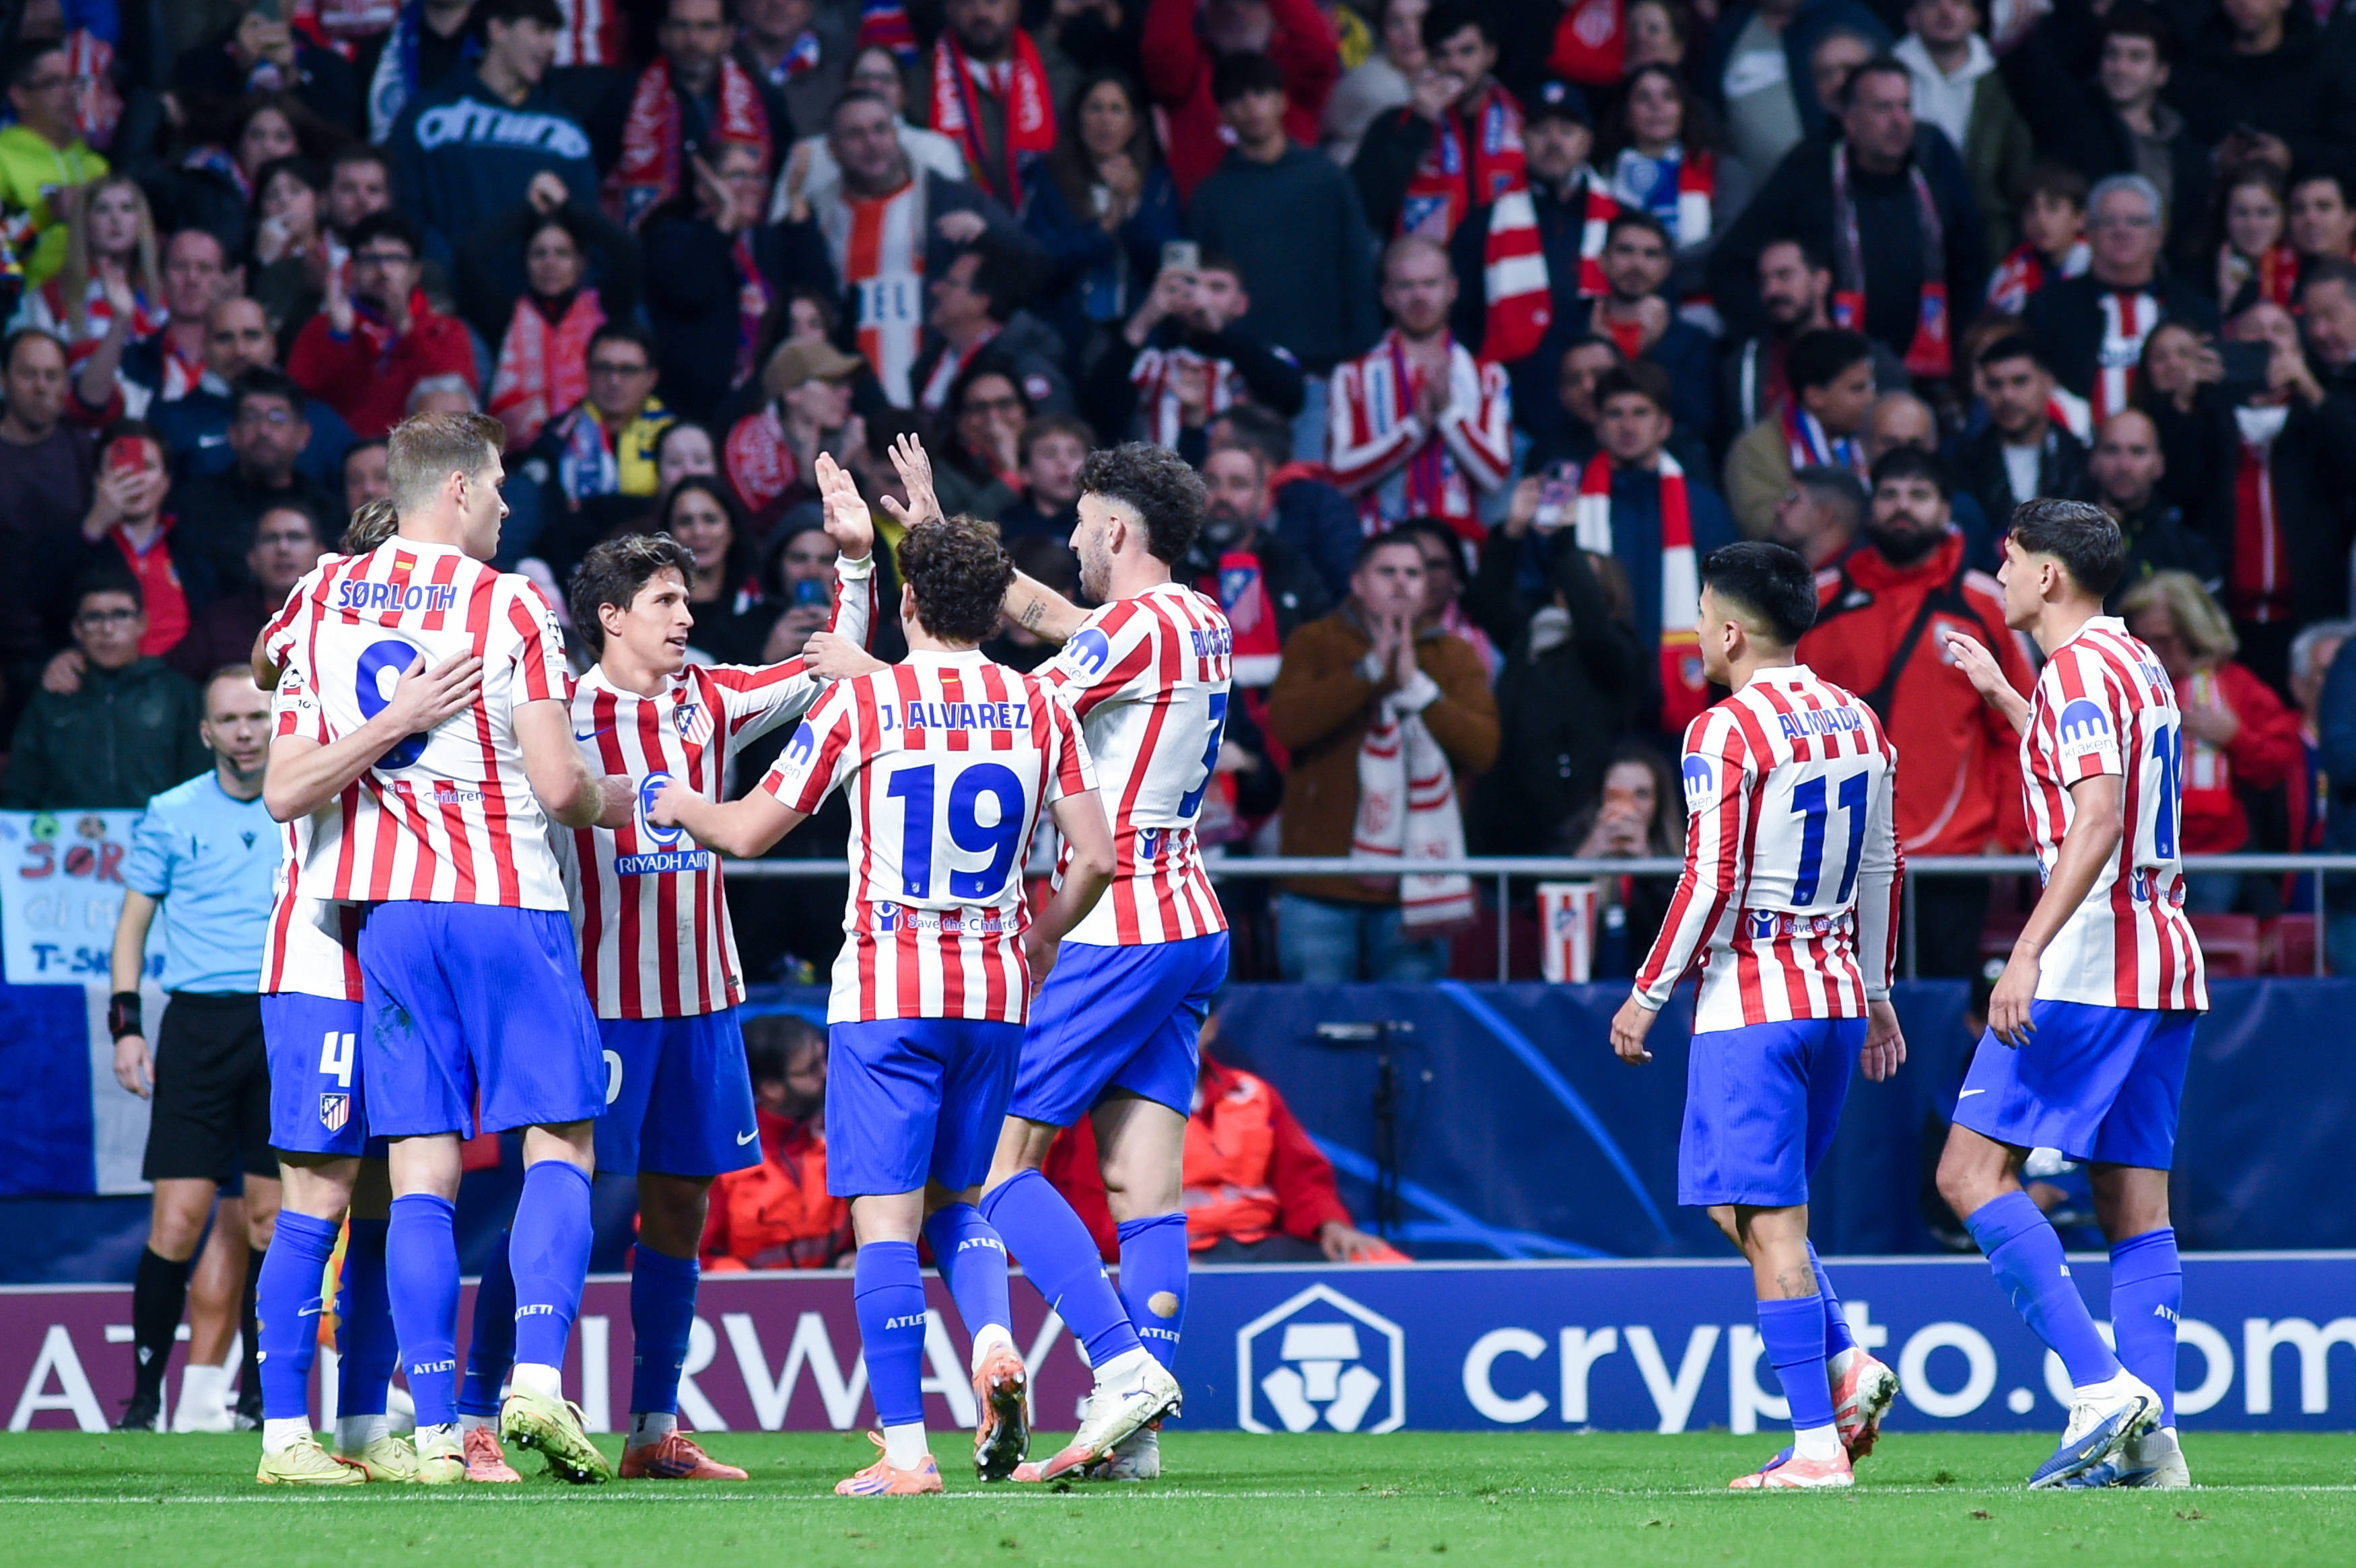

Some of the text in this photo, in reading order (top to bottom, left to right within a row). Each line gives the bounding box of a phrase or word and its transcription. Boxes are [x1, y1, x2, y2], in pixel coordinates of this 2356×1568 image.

[338, 580, 457, 610] SØRLOTH
[881, 703, 1029, 731] J. ALVAREZ
[1777, 707, 1865, 740] ALMADA
[2065, 739, 2114, 759] kraken
[887, 763, 1025, 899] 19
[1790, 770, 1869, 906] 11
[619, 851, 707, 874] RIYADH AIR
[908, 914, 940, 929] Save
[942, 918, 966, 931] the
[1785, 919, 1812, 933] Save
[319, 1032, 355, 1088] 4
